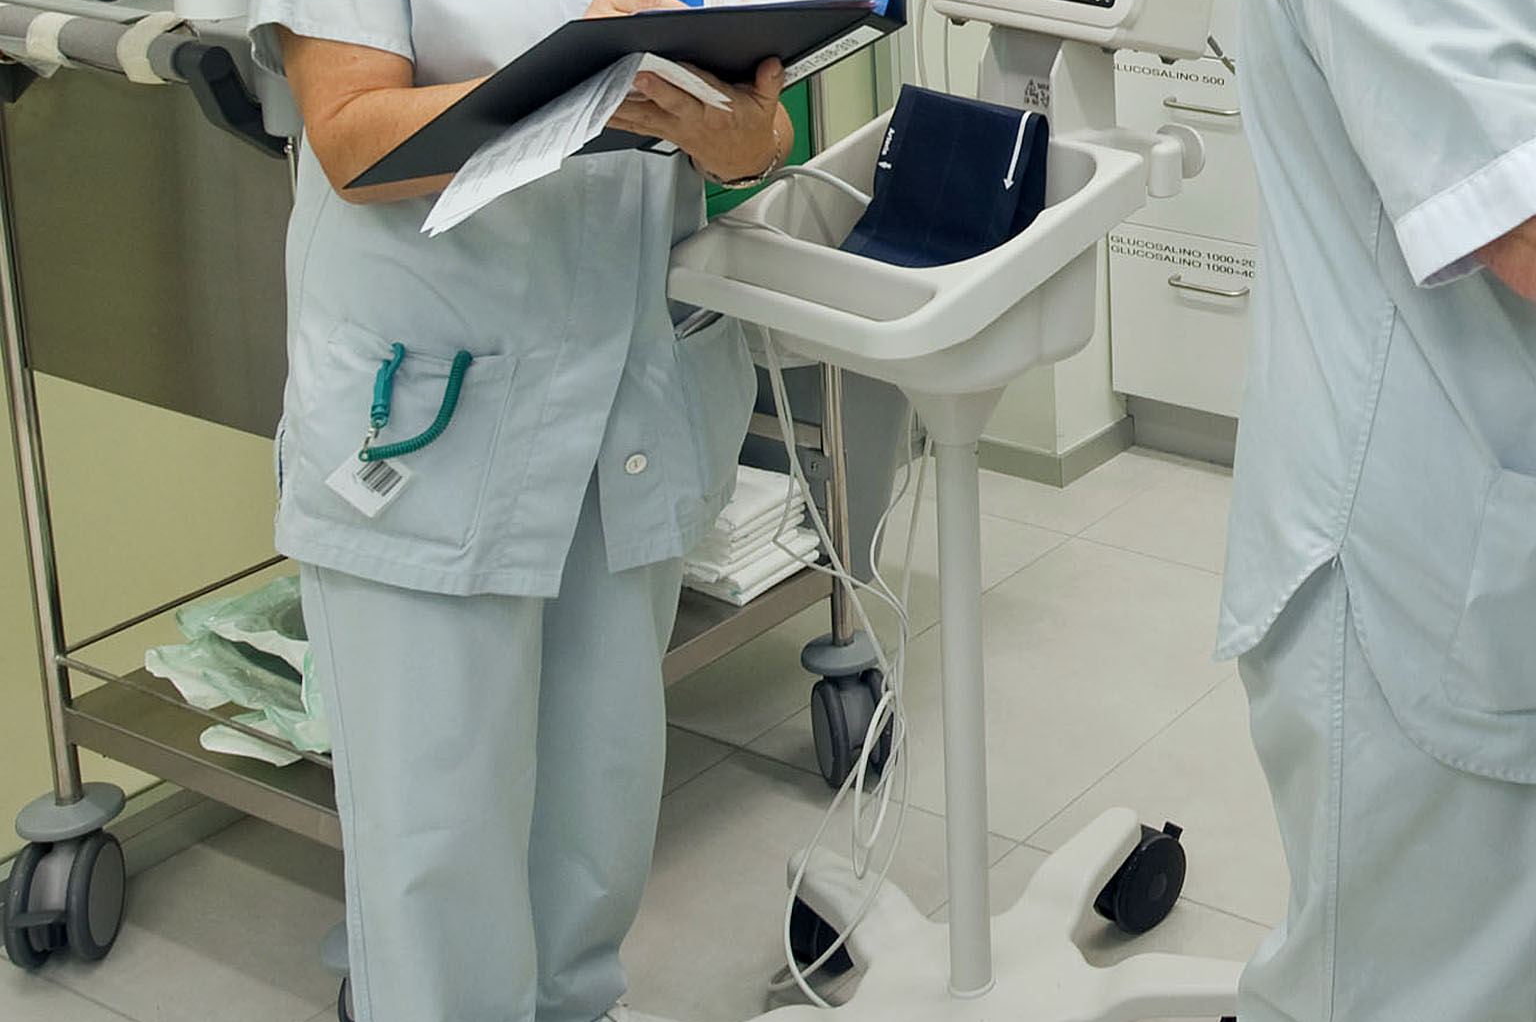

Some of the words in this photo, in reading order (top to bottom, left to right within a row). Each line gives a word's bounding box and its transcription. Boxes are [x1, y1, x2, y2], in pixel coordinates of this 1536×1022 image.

[1202, 75, 1225, 86] 500
[1110, 234, 1202, 259] GLUCOSALINO
[1110, 244, 1202, 269] GLUCOSALINO
